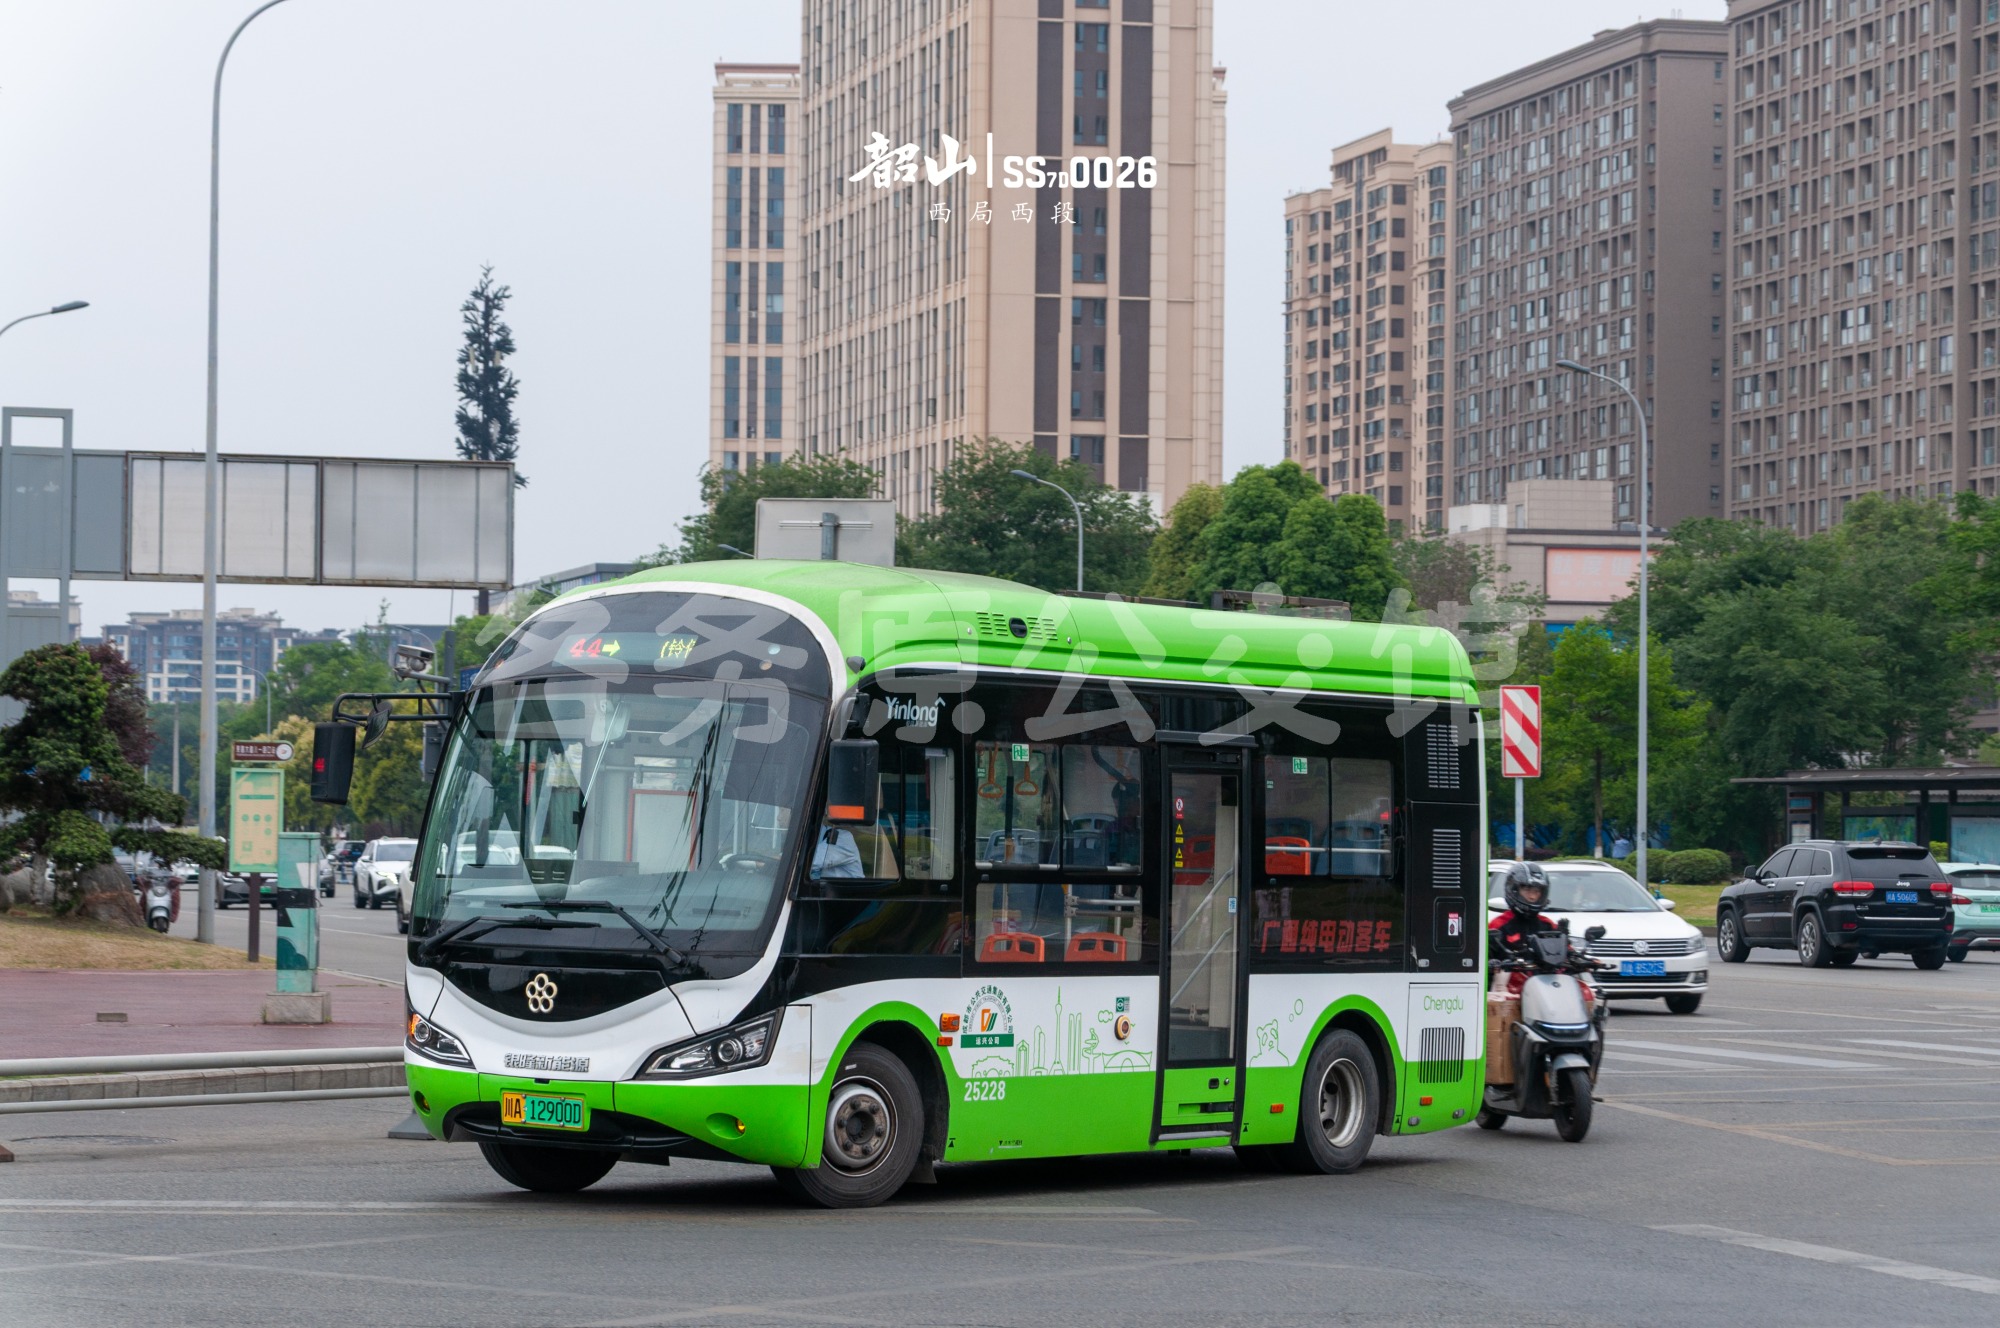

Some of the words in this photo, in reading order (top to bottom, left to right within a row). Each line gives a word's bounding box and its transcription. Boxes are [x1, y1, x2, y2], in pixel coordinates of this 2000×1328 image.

[569, 638, 603, 659] 44
[885, 696, 941, 727] Yinlong
[1261, 920, 1392, 954] 广通纯电动客车
[1423, 995, 1464, 1015] Chengdu
[504, 1052, 590, 1073] 银隆新能源
[963, 1080, 1006, 1102] 25228
